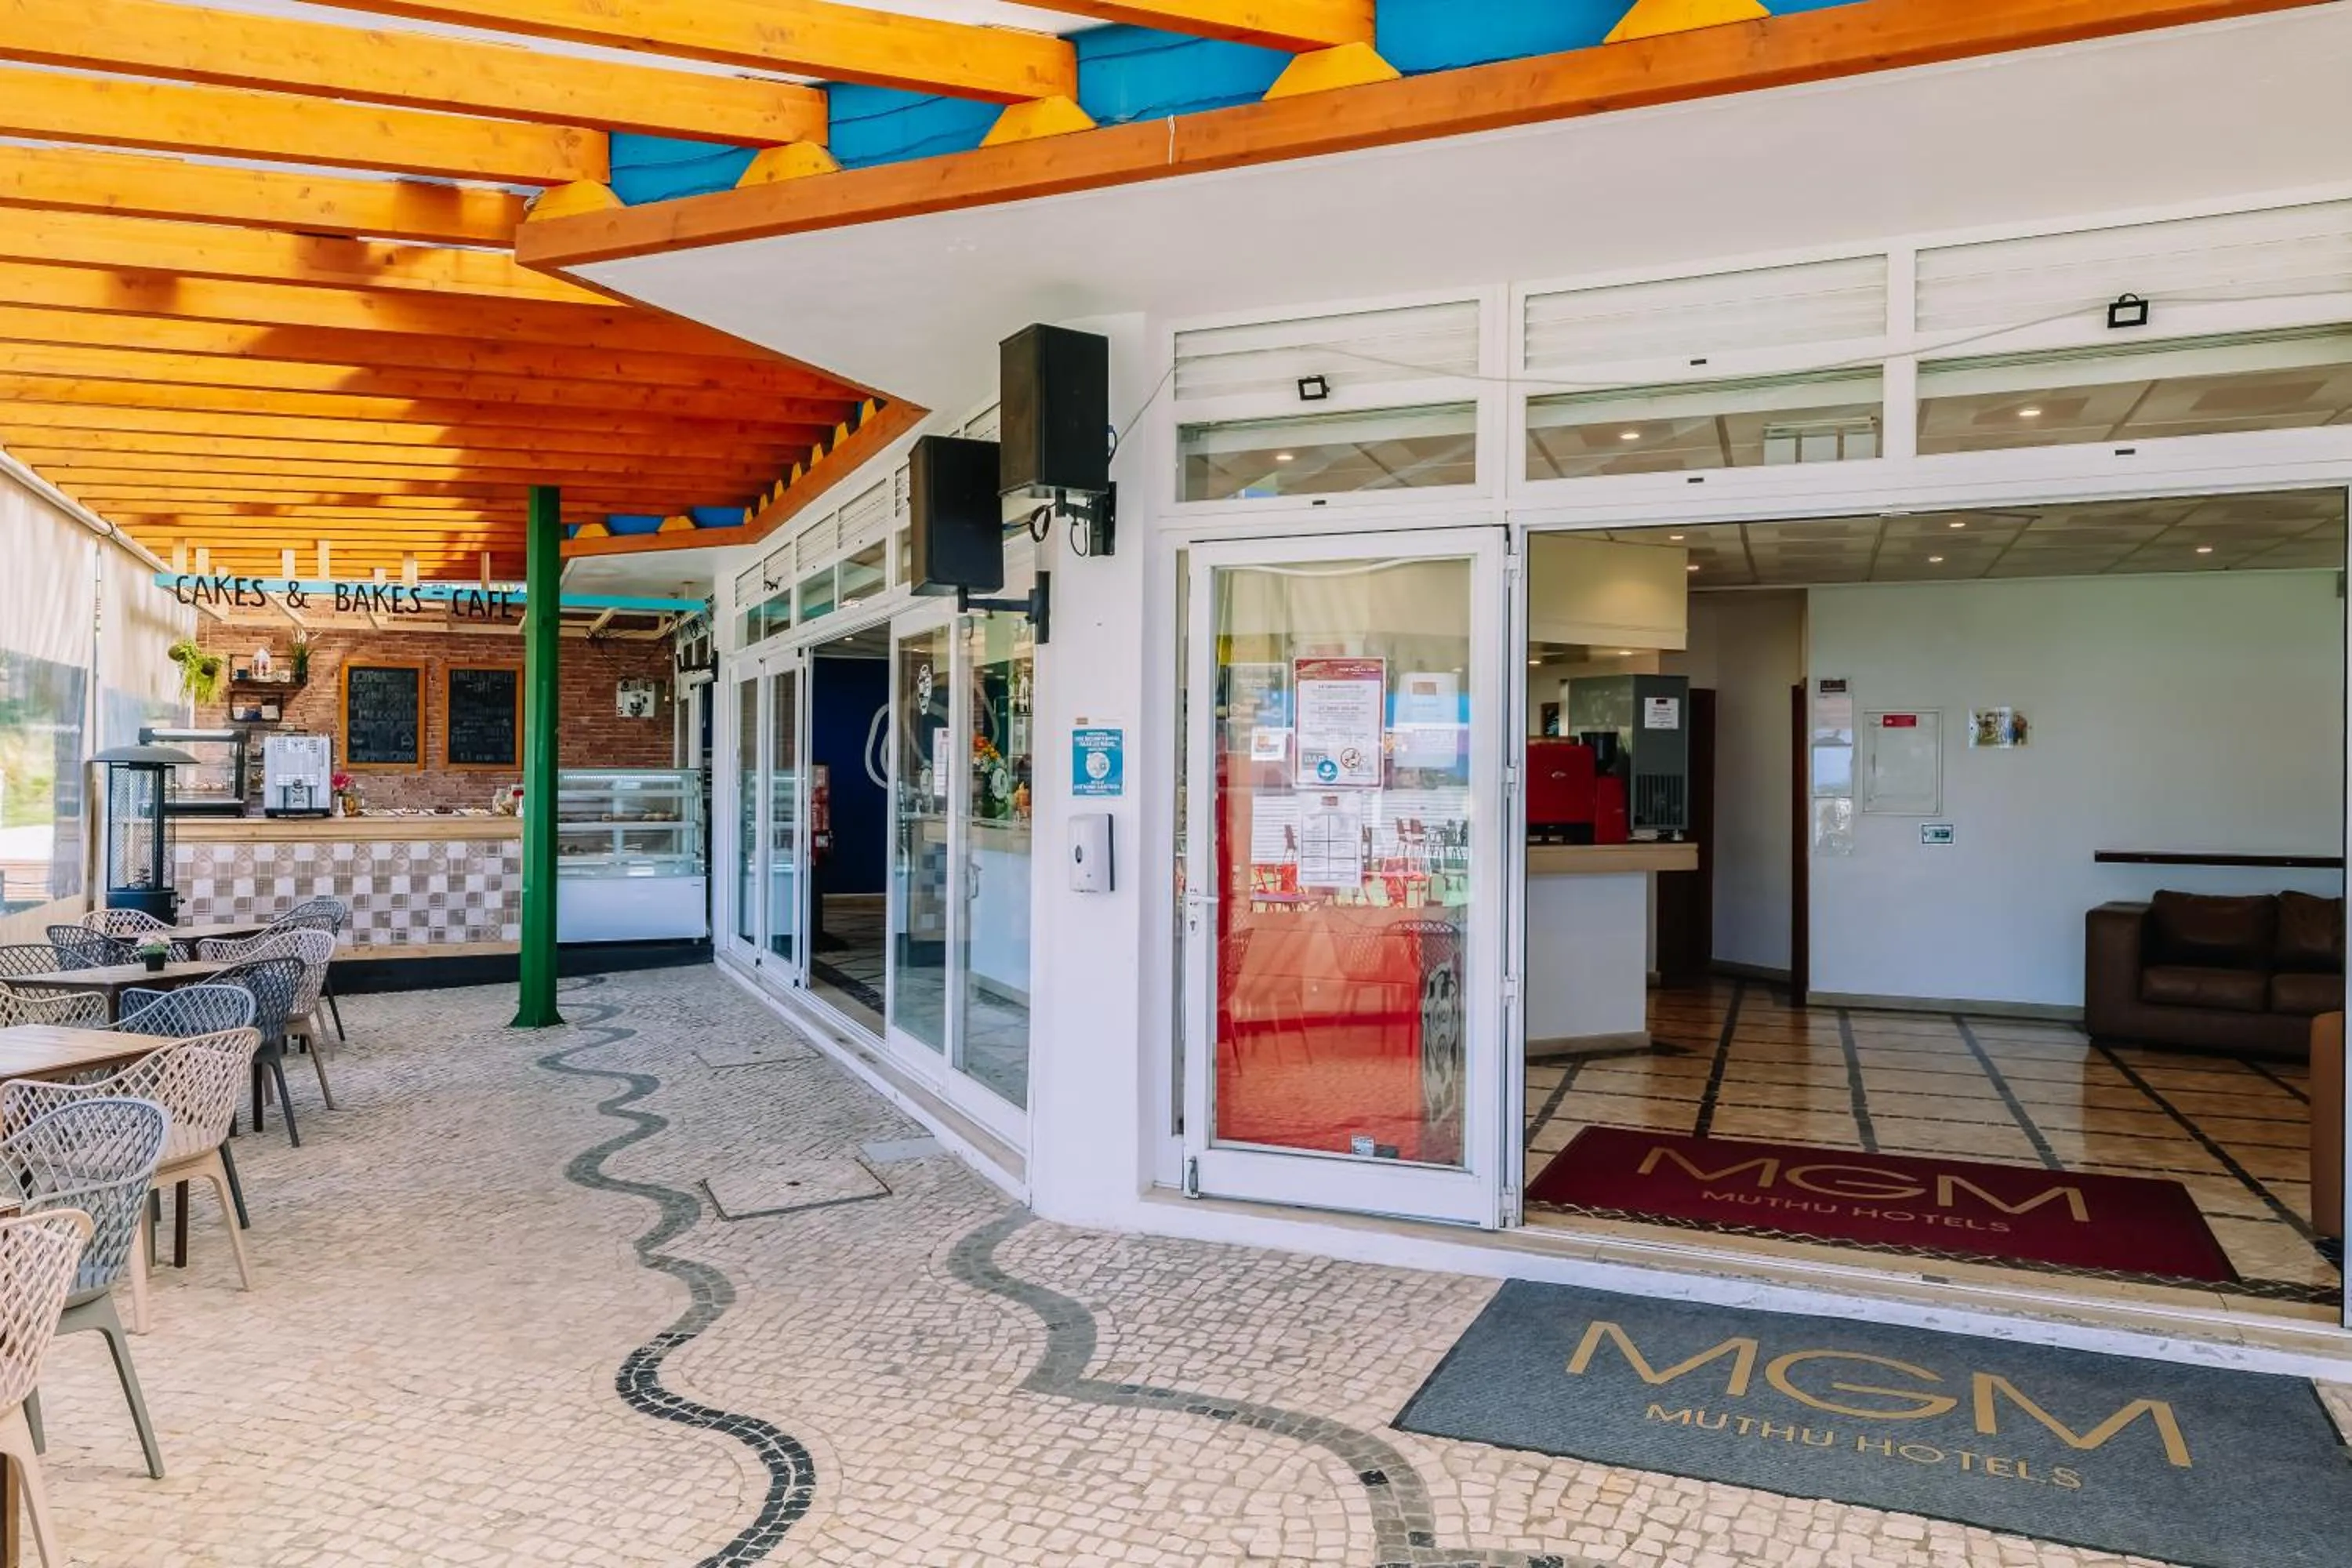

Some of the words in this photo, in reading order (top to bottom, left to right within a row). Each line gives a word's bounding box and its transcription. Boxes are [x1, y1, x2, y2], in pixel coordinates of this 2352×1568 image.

[176, 575, 266, 607] CAKES
[286, 581, 310, 608] &
[335, 583, 421, 613] BAKES
[1637, 1146, 2090, 1221] MGM
[1701, 1190, 1838, 1213] MUTHU
[1853, 1207, 2011, 1232] HOTELS
[1566, 1320, 2193, 1468] MGM
[1646, 1403, 1834, 1446] MUTHU
[1857, 1435, 2082, 1489] HOTELS
